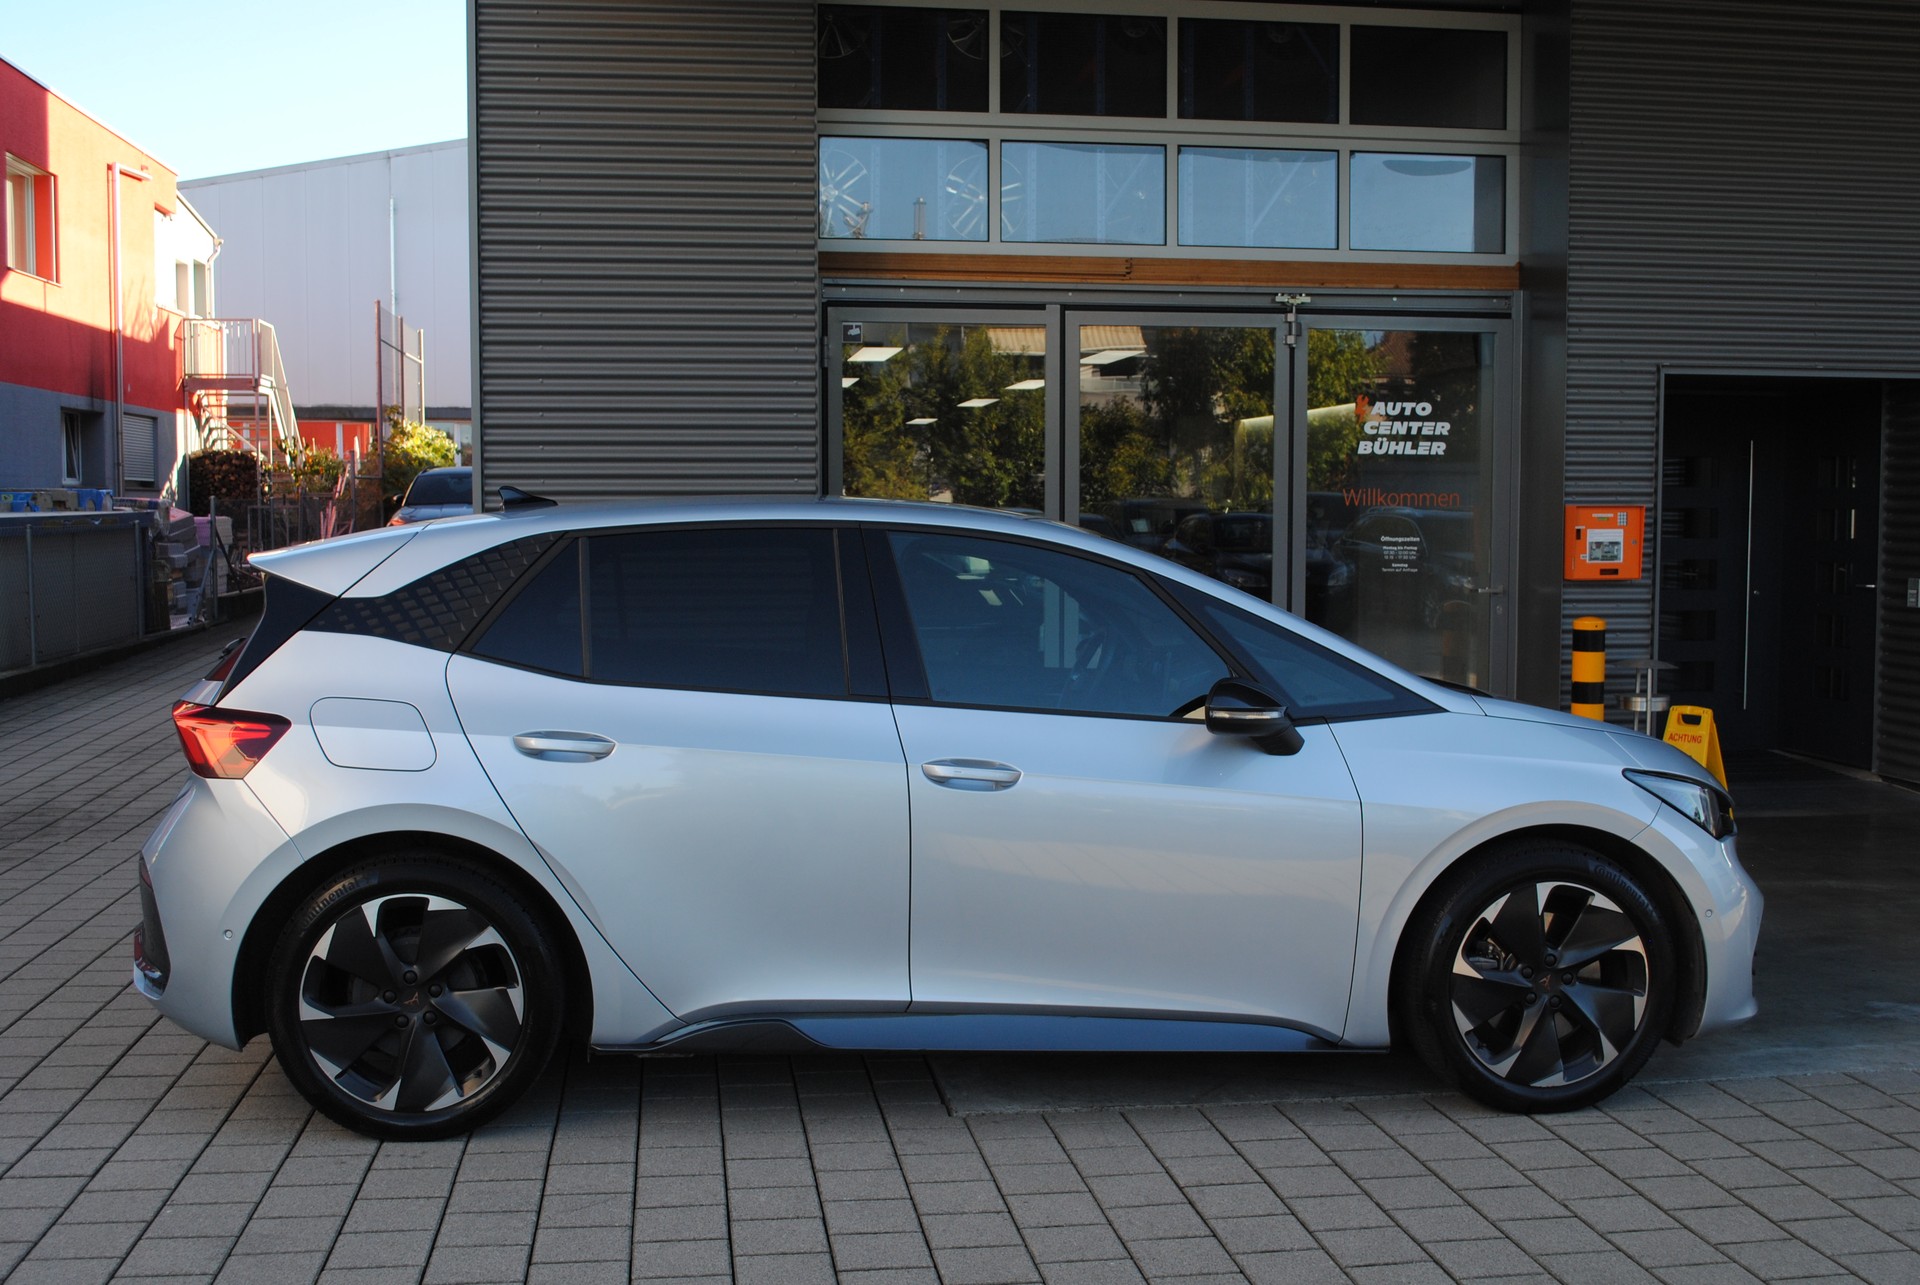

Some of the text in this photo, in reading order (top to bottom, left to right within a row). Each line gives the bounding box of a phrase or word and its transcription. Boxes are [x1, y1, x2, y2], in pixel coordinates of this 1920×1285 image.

[1371, 401, 1432, 416] AUTO
[1363, 421, 1451, 435] CENTER
[1357, 437, 1446, 455] BÜHLER
[1342, 488, 1460, 507] Willkommen
[1668, 732, 1702, 744] ACHTUNG
